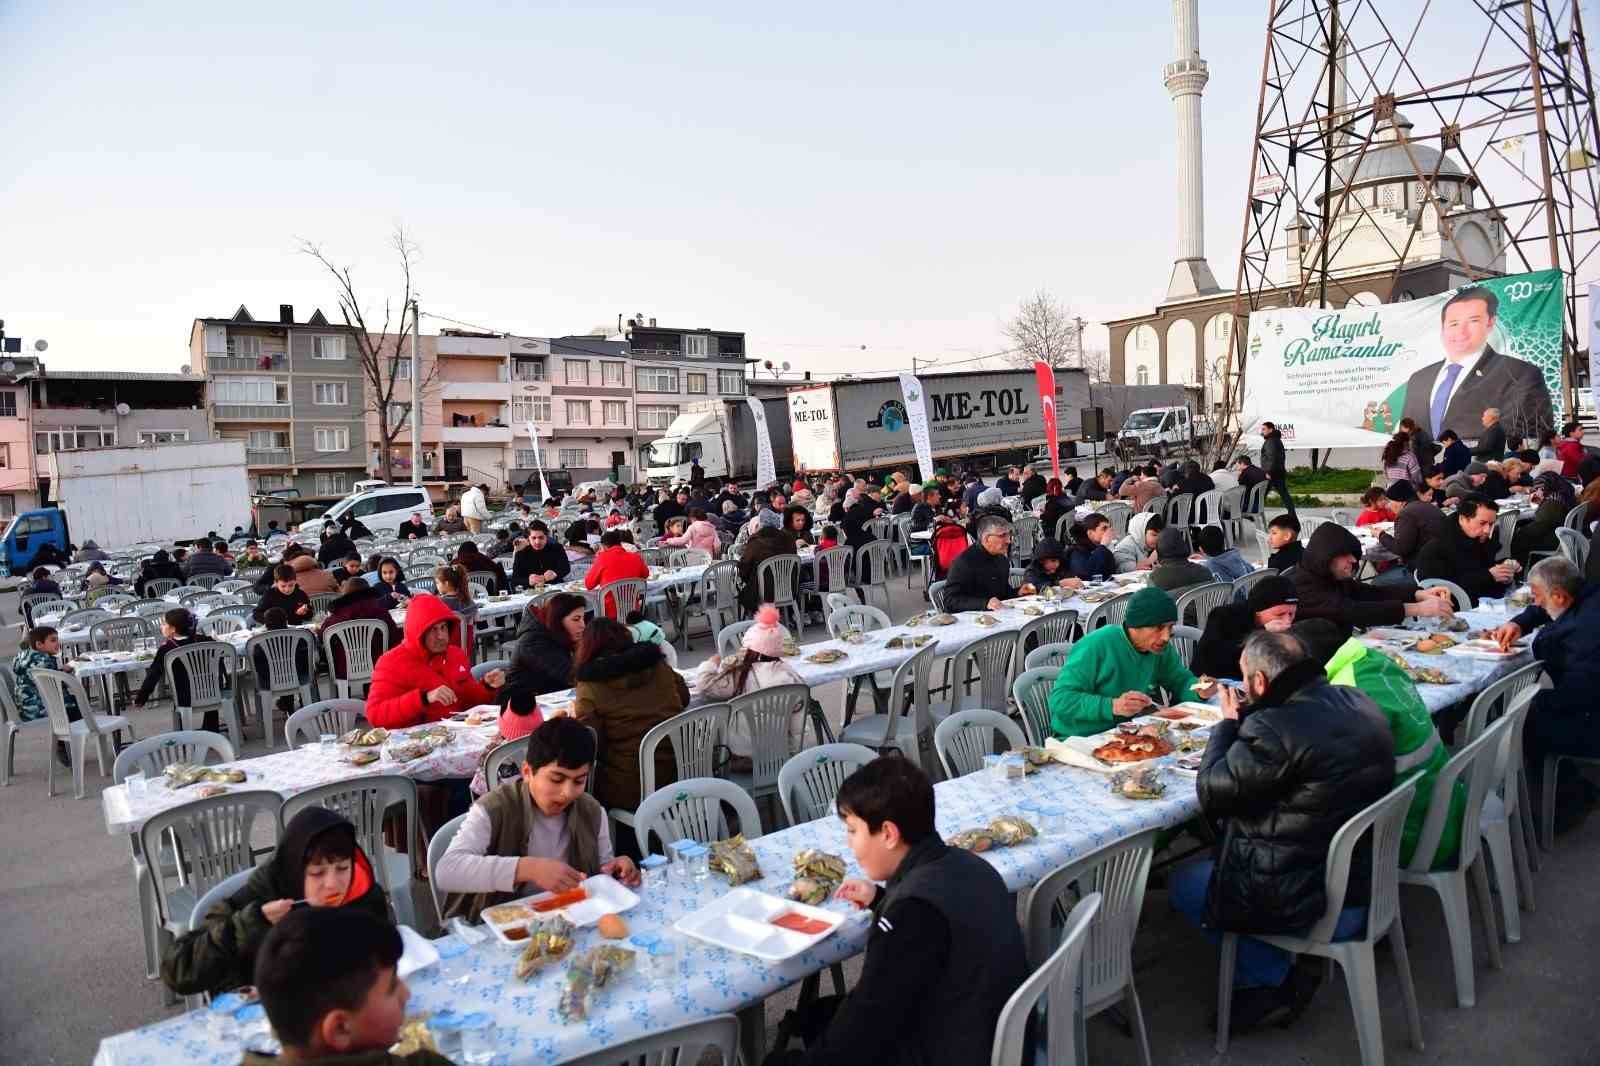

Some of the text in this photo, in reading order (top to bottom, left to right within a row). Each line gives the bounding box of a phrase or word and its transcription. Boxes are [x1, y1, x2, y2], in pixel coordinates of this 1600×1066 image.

[1284, 336, 1403, 367] Ramazanlar
[794, 409, 829, 423] ME-TOL
[930, 388, 1029, 422] ME-TOL
